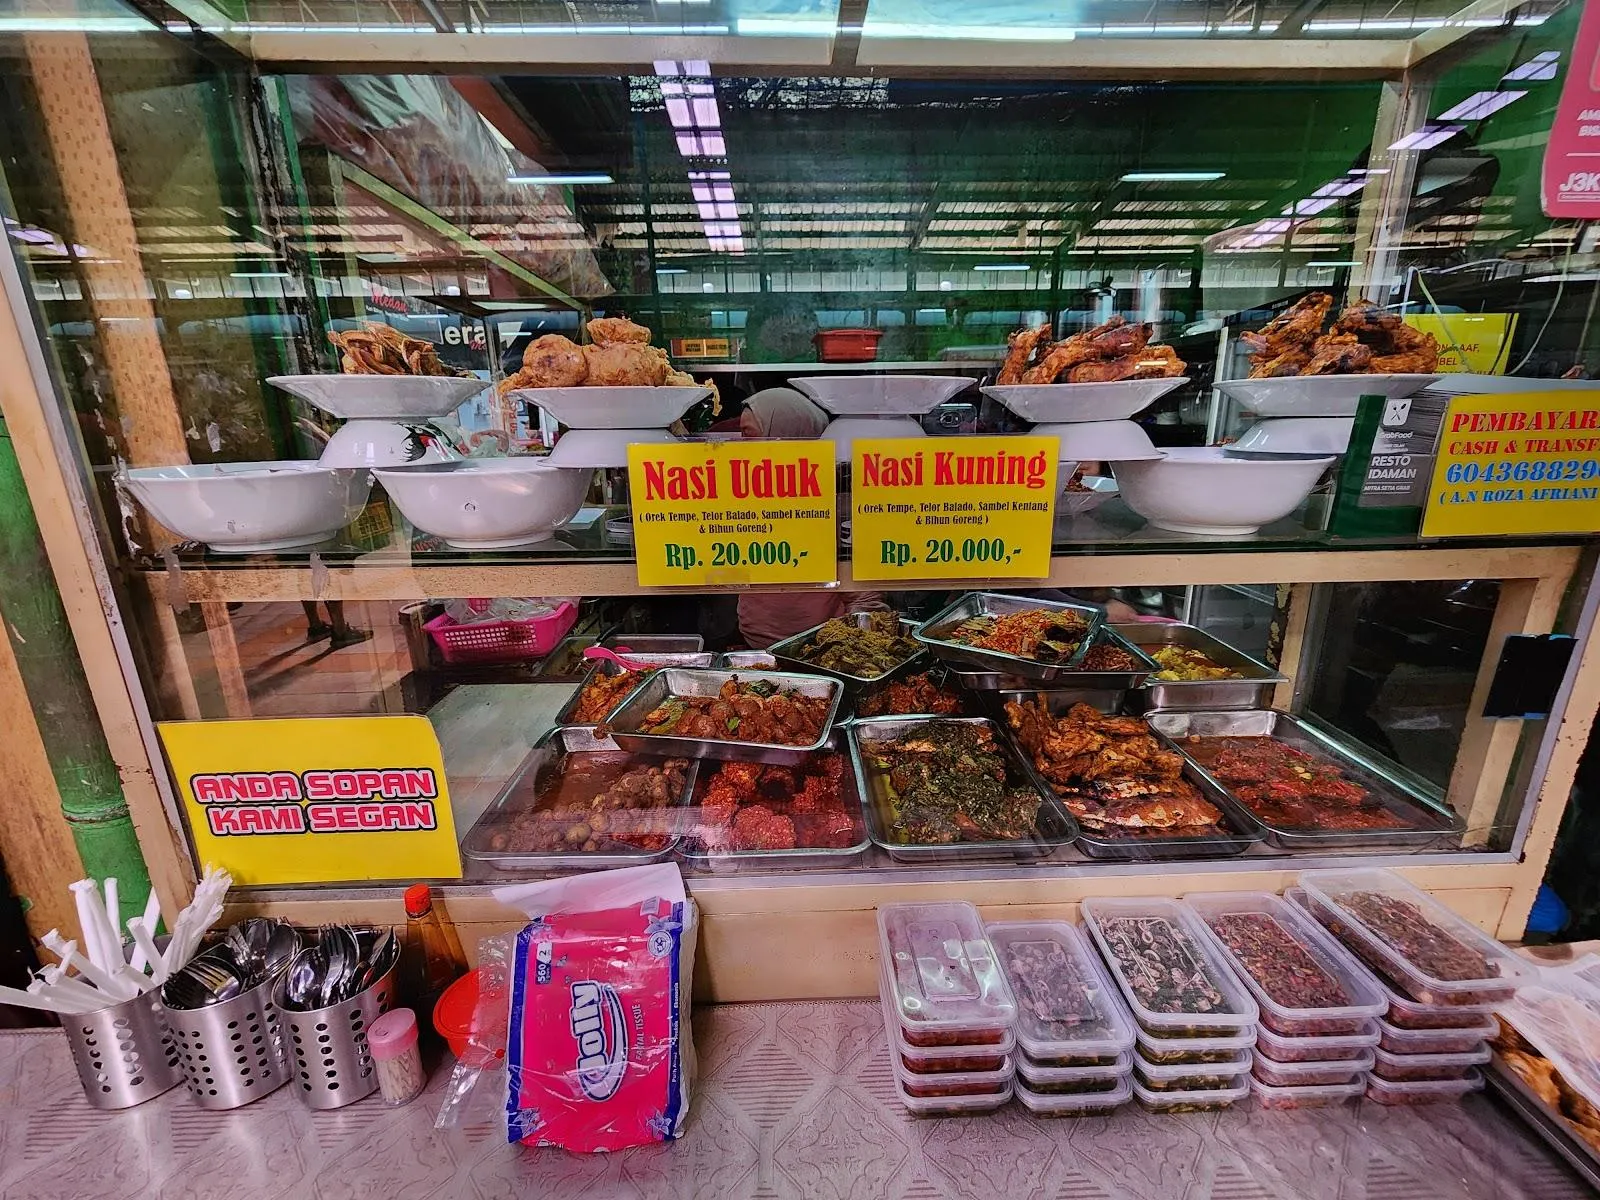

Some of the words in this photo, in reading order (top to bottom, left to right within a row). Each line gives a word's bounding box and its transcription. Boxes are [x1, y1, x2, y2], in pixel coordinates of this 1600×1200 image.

[1436, 357, 1457, 366] BEL
[1450, 410, 1600, 433] PEMBAYAR
[1449, 440, 1499, 456] CASH
[1504, 439, 1519, 454] &
[1524, 437, 1600, 453] TRANSF
[862, 451, 924, 487] Nasi
[934, 450, 1046, 489] Kuning
[1371, 455, 1411, 467] RESTO
[642, 459, 718, 501] Nasi
[728, 457, 822, 499] Uduk
[1367, 468, 1417, 479] IDAMAN
[1446, 459, 1600, 483] 604368829
[1482, 489, 1524, 502] ROZA
[1530, 487, 1599, 501] AFRIANI
[645, 511, 666, 521] Orek
[669, 511, 699, 522] Tempe,
[702, 510, 723, 521] Telor
[726, 510, 759, 521] Balado,
[761, 509, 792, 520] Sambel
[795, 508, 830, 520] Kentang
[863, 503, 884, 513] Orek
[887, 502, 917, 514] Tempe,
[920, 502, 941, 512] Telor
[943, 501, 976, 512] Balado,
[978, 501, 1009, 511] Sambel
[1012, 500, 1048, 512] Kentang
[699, 524, 706, 534] &
[709, 523, 734, 533] Bihun
[736, 523, 767, 534] Goreng
[915, 515, 923, 525] &
[925, 515, 950, 525] Bihun
[953, 514, 983, 525] Goreng
[665, 543, 703, 570] Rp.
[711, 541, 809, 568] 20.000,-
[881, 540, 917, 566] Rp.
[925, 538, 1022, 565] 20.000,-
[193, 774, 302, 802] ANDA
[304, 770, 436, 800] SOPAN
[209, 806, 305, 833] KAMI
[307, 803, 435, 831] SEGAN
[538, 963, 547, 982] 560
[631, 1002, 644, 1031] TISSUE
